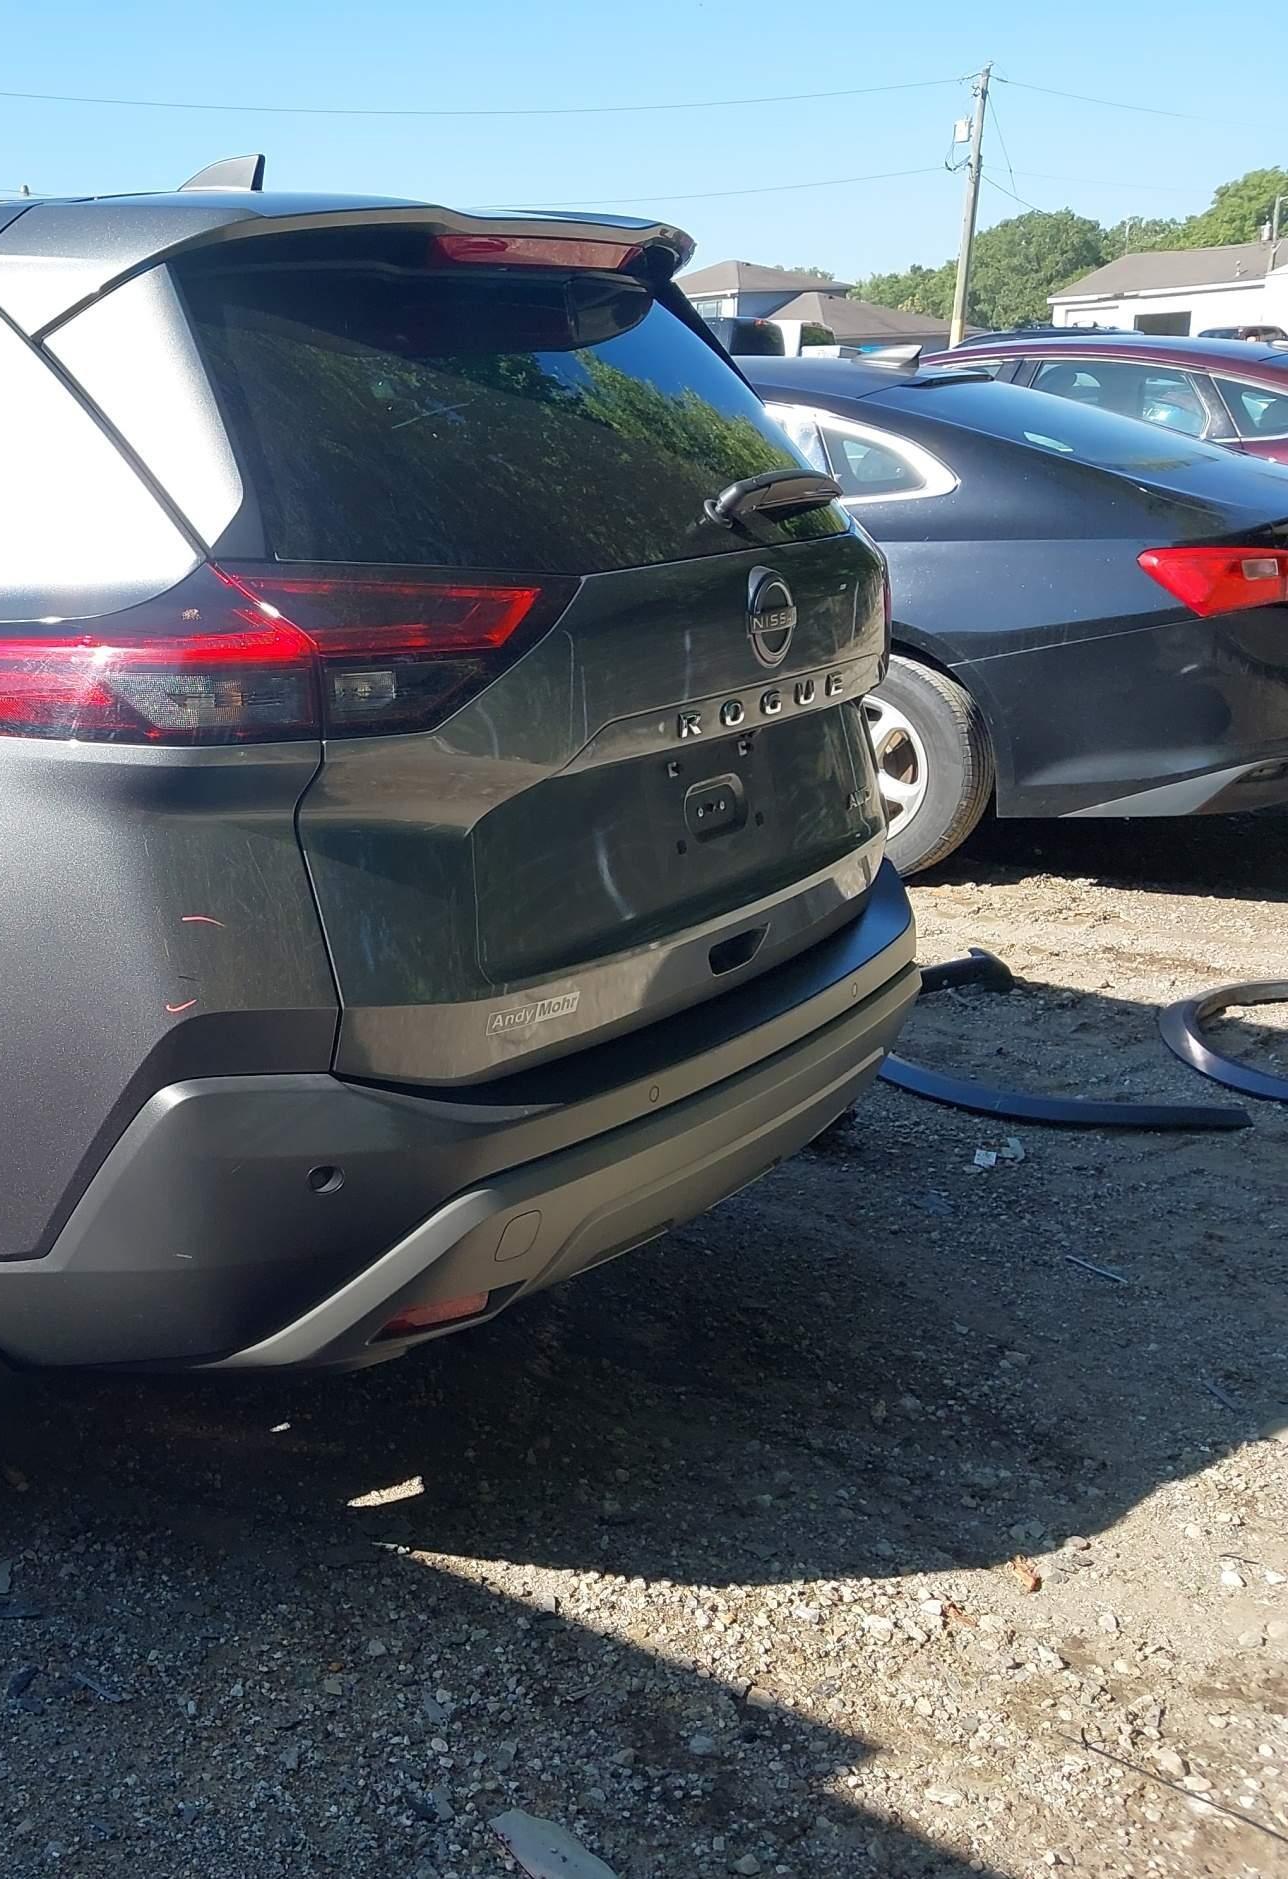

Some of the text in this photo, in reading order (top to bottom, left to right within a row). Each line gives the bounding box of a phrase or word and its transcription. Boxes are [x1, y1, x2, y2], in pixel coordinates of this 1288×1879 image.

[678, 671, 844, 739] ROGUE
[492, 995, 578, 1029] Andy Mohr
